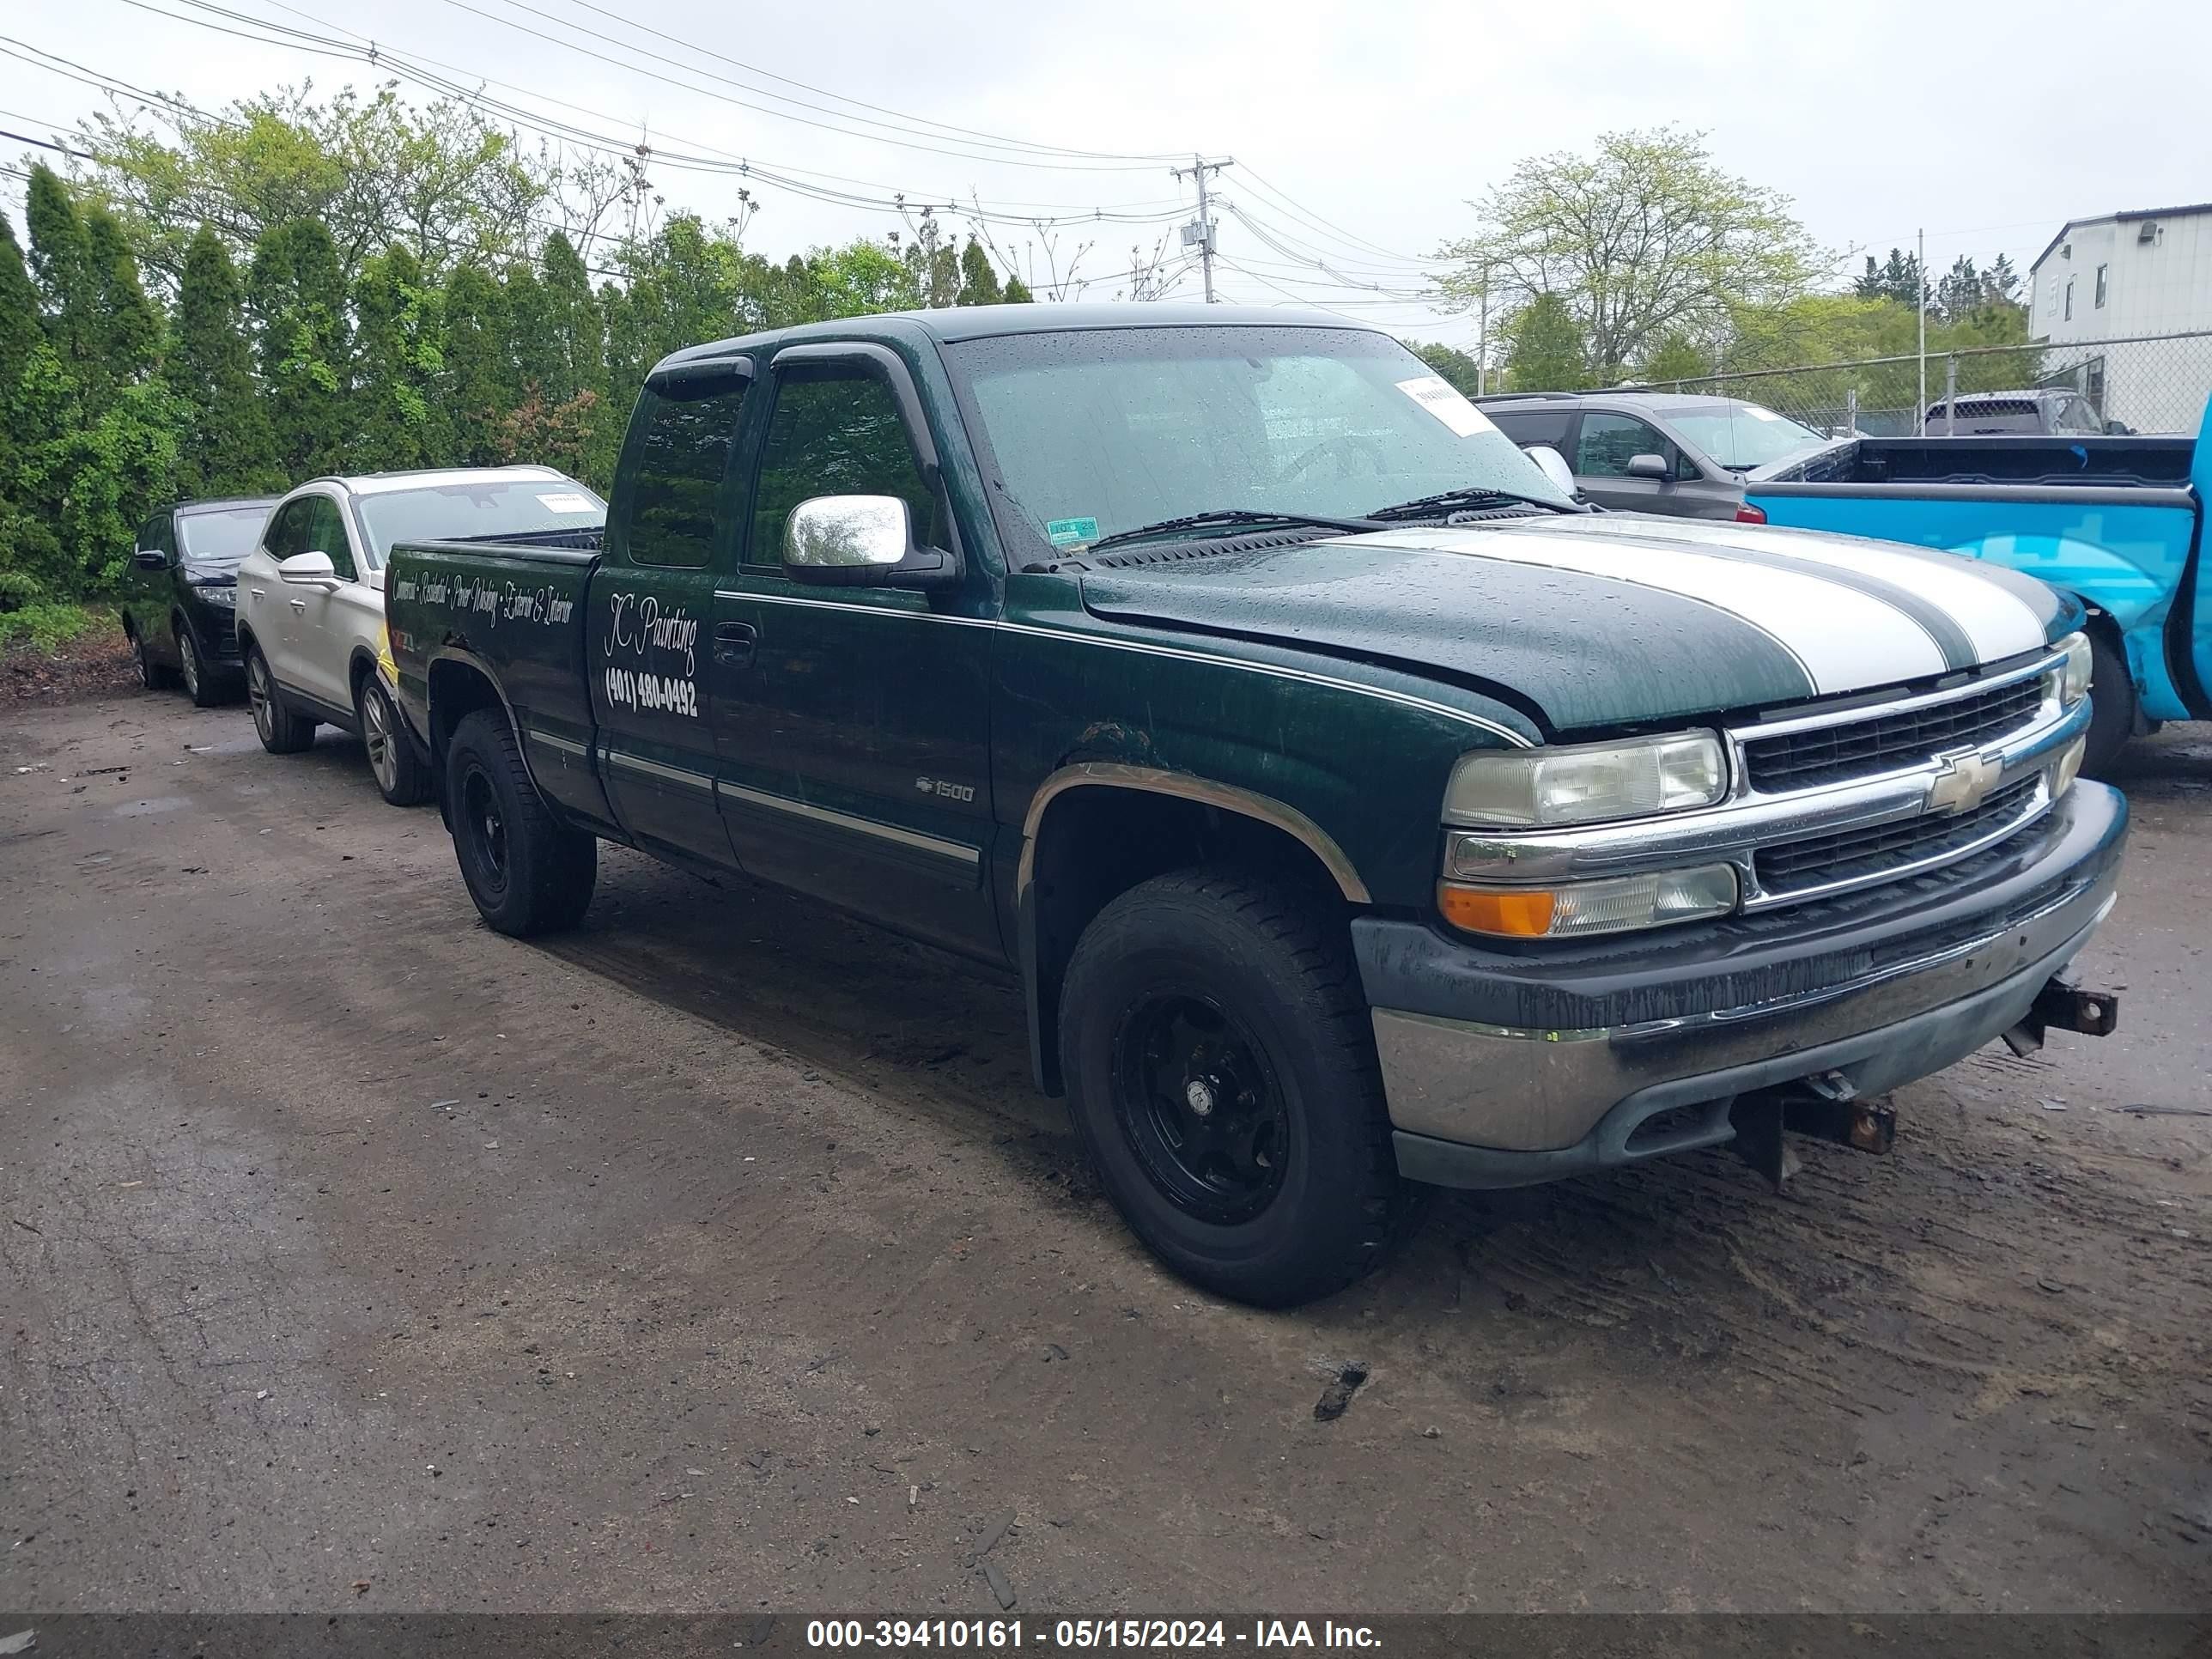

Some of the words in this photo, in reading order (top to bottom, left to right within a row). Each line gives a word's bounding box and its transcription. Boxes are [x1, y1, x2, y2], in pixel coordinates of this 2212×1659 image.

[450, 574, 471, 611] Power
[503, 580, 534, 620] Exterior
[533, 588, 544, 623] &
[544, 585, 573, 626] Interior
[635, 596, 697, 677] Painting
[605, 666, 636, 714] (401)
[637, 672, 698, 718] 480-0492
[936, 781, 975, 802] 1500
